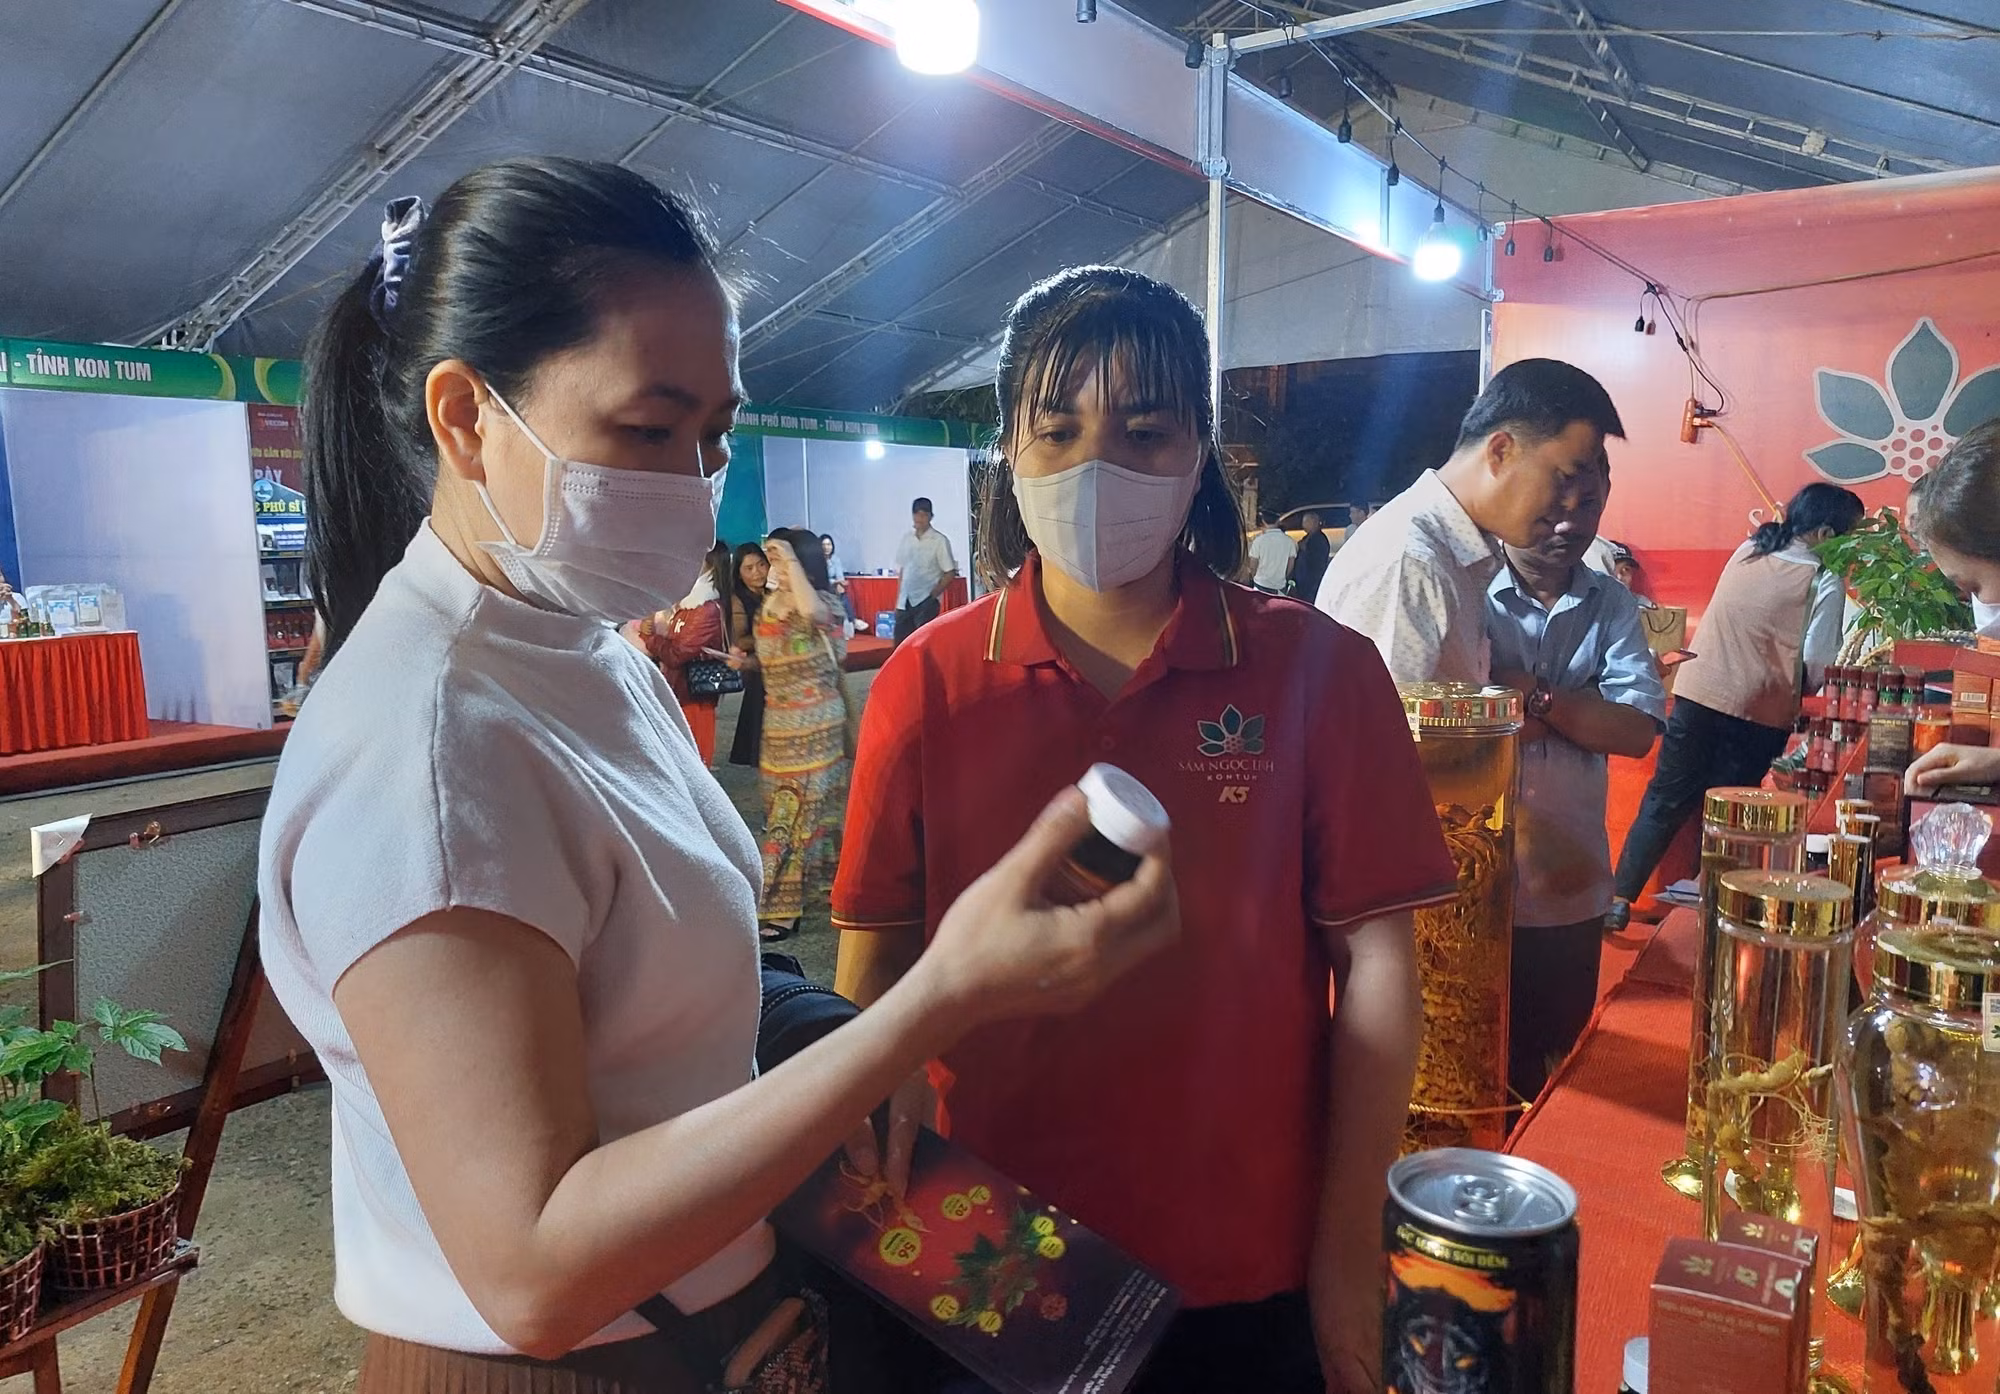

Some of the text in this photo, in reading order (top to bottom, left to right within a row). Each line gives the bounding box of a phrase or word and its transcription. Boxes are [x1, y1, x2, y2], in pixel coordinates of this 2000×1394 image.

[26, 347, 69, 376] TỈNH
[74, 357, 110, 379] KON
[114, 360, 152, 382] TUM
[780, 415, 798, 430] KON
[800, 417, 818, 430] TUM
[1219, 786, 1250, 803] K5
